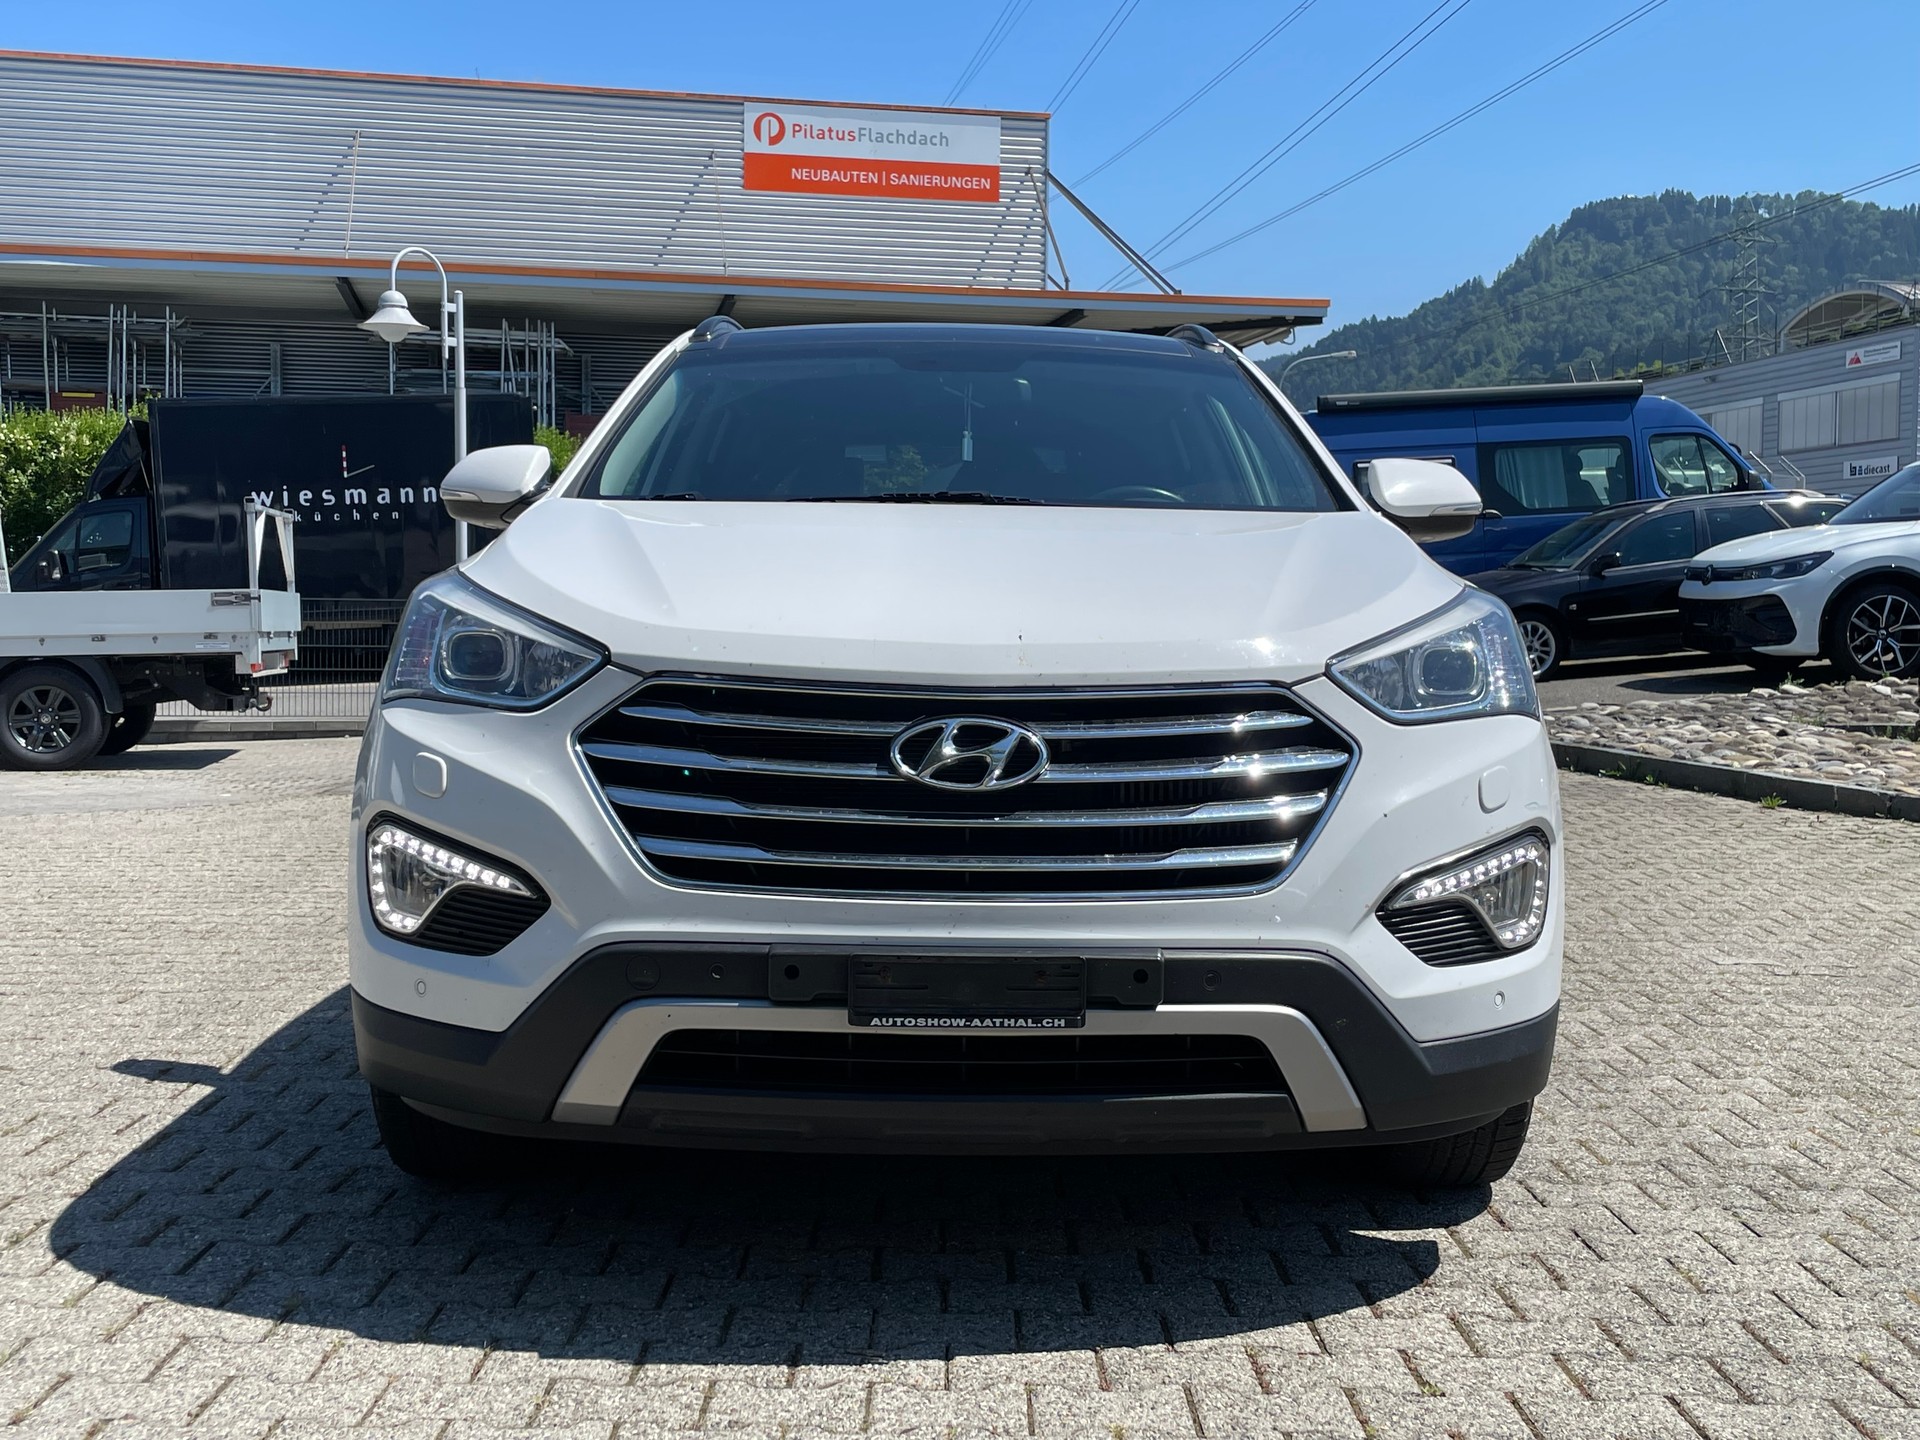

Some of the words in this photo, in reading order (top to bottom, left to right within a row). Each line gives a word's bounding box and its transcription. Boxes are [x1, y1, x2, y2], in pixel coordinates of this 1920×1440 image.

[791, 168, 878, 184] NEUBAUTEN
[889, 173, 991, 189] SANIERUNGEN
[1863, 464, 1890, 475] diecast
[251, 485, 437, 507] wiesmann
[294, 510, 399, 522] küchen
[869, 1016, 1066, 1028] AUTOSHOW-AATHAL.CH
